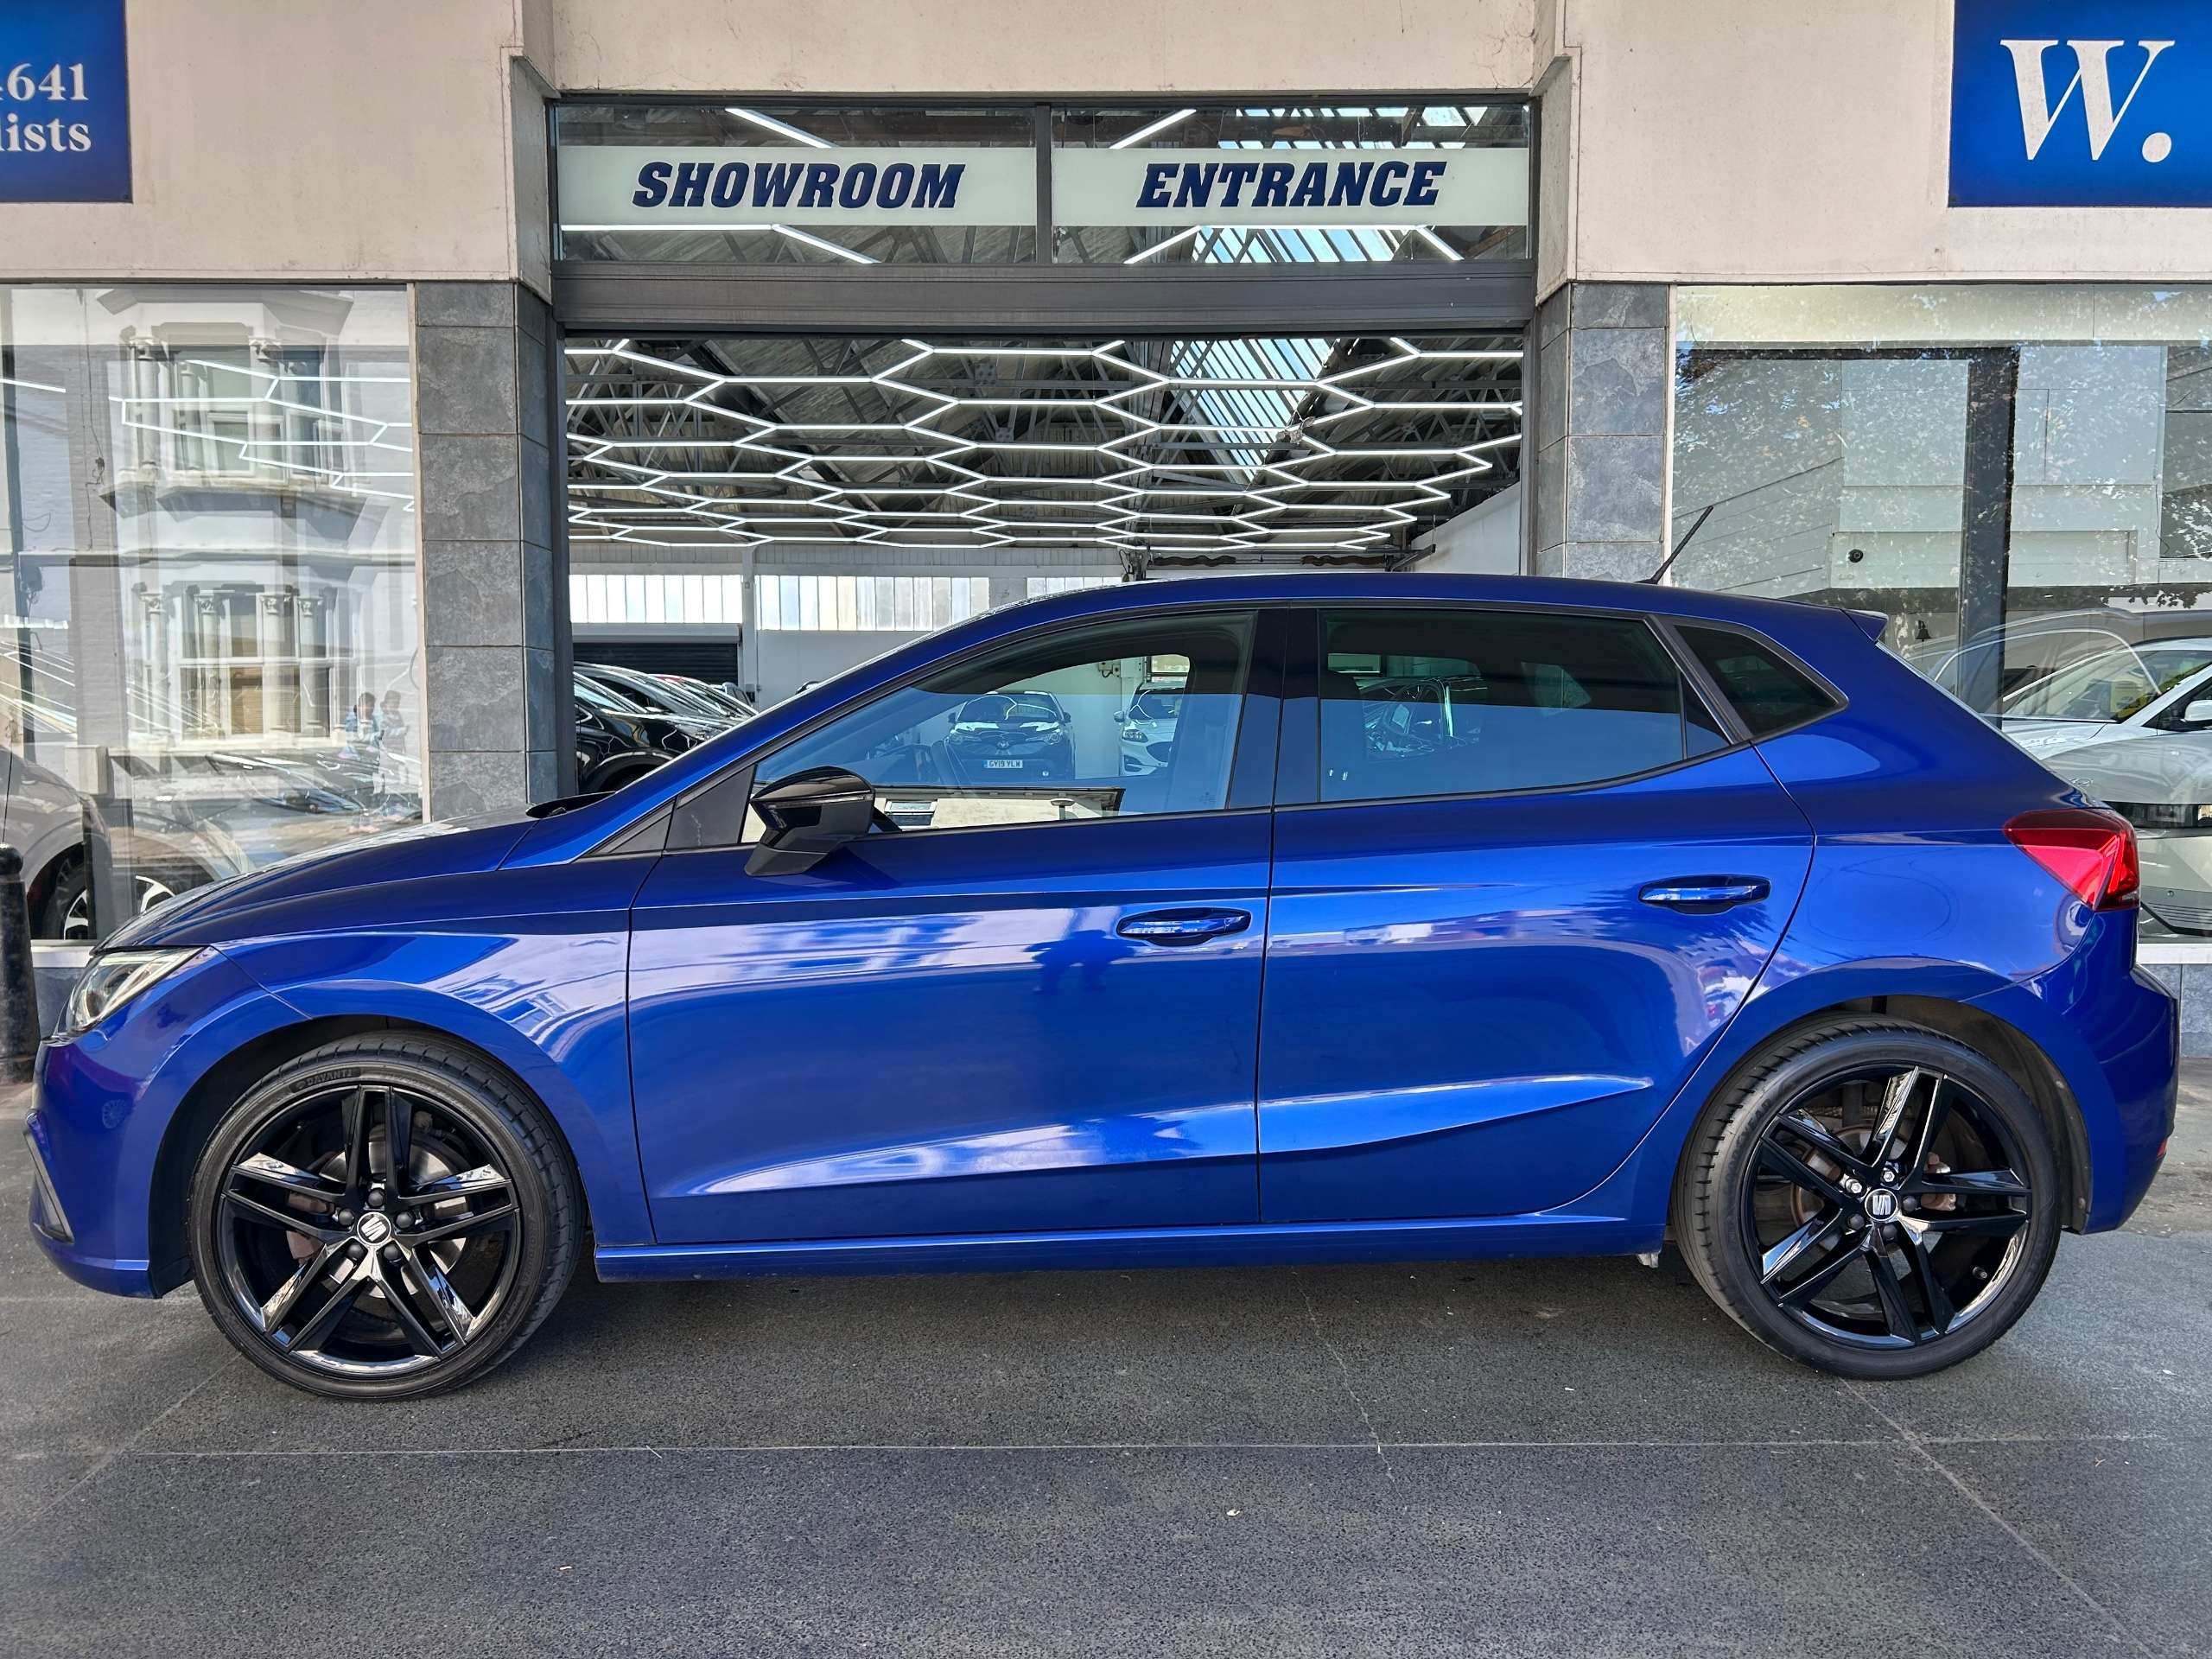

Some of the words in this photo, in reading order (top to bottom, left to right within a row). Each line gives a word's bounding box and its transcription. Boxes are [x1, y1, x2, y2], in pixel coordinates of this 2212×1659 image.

[0, 63, 89, 101] 641
[1999, 39, 2176, 163] W.
[0, 112, 92, 152] ists
[632, 161, 966, 209] SHOWROOM
[1135, 161, 1447, 208] ENTRANCE
